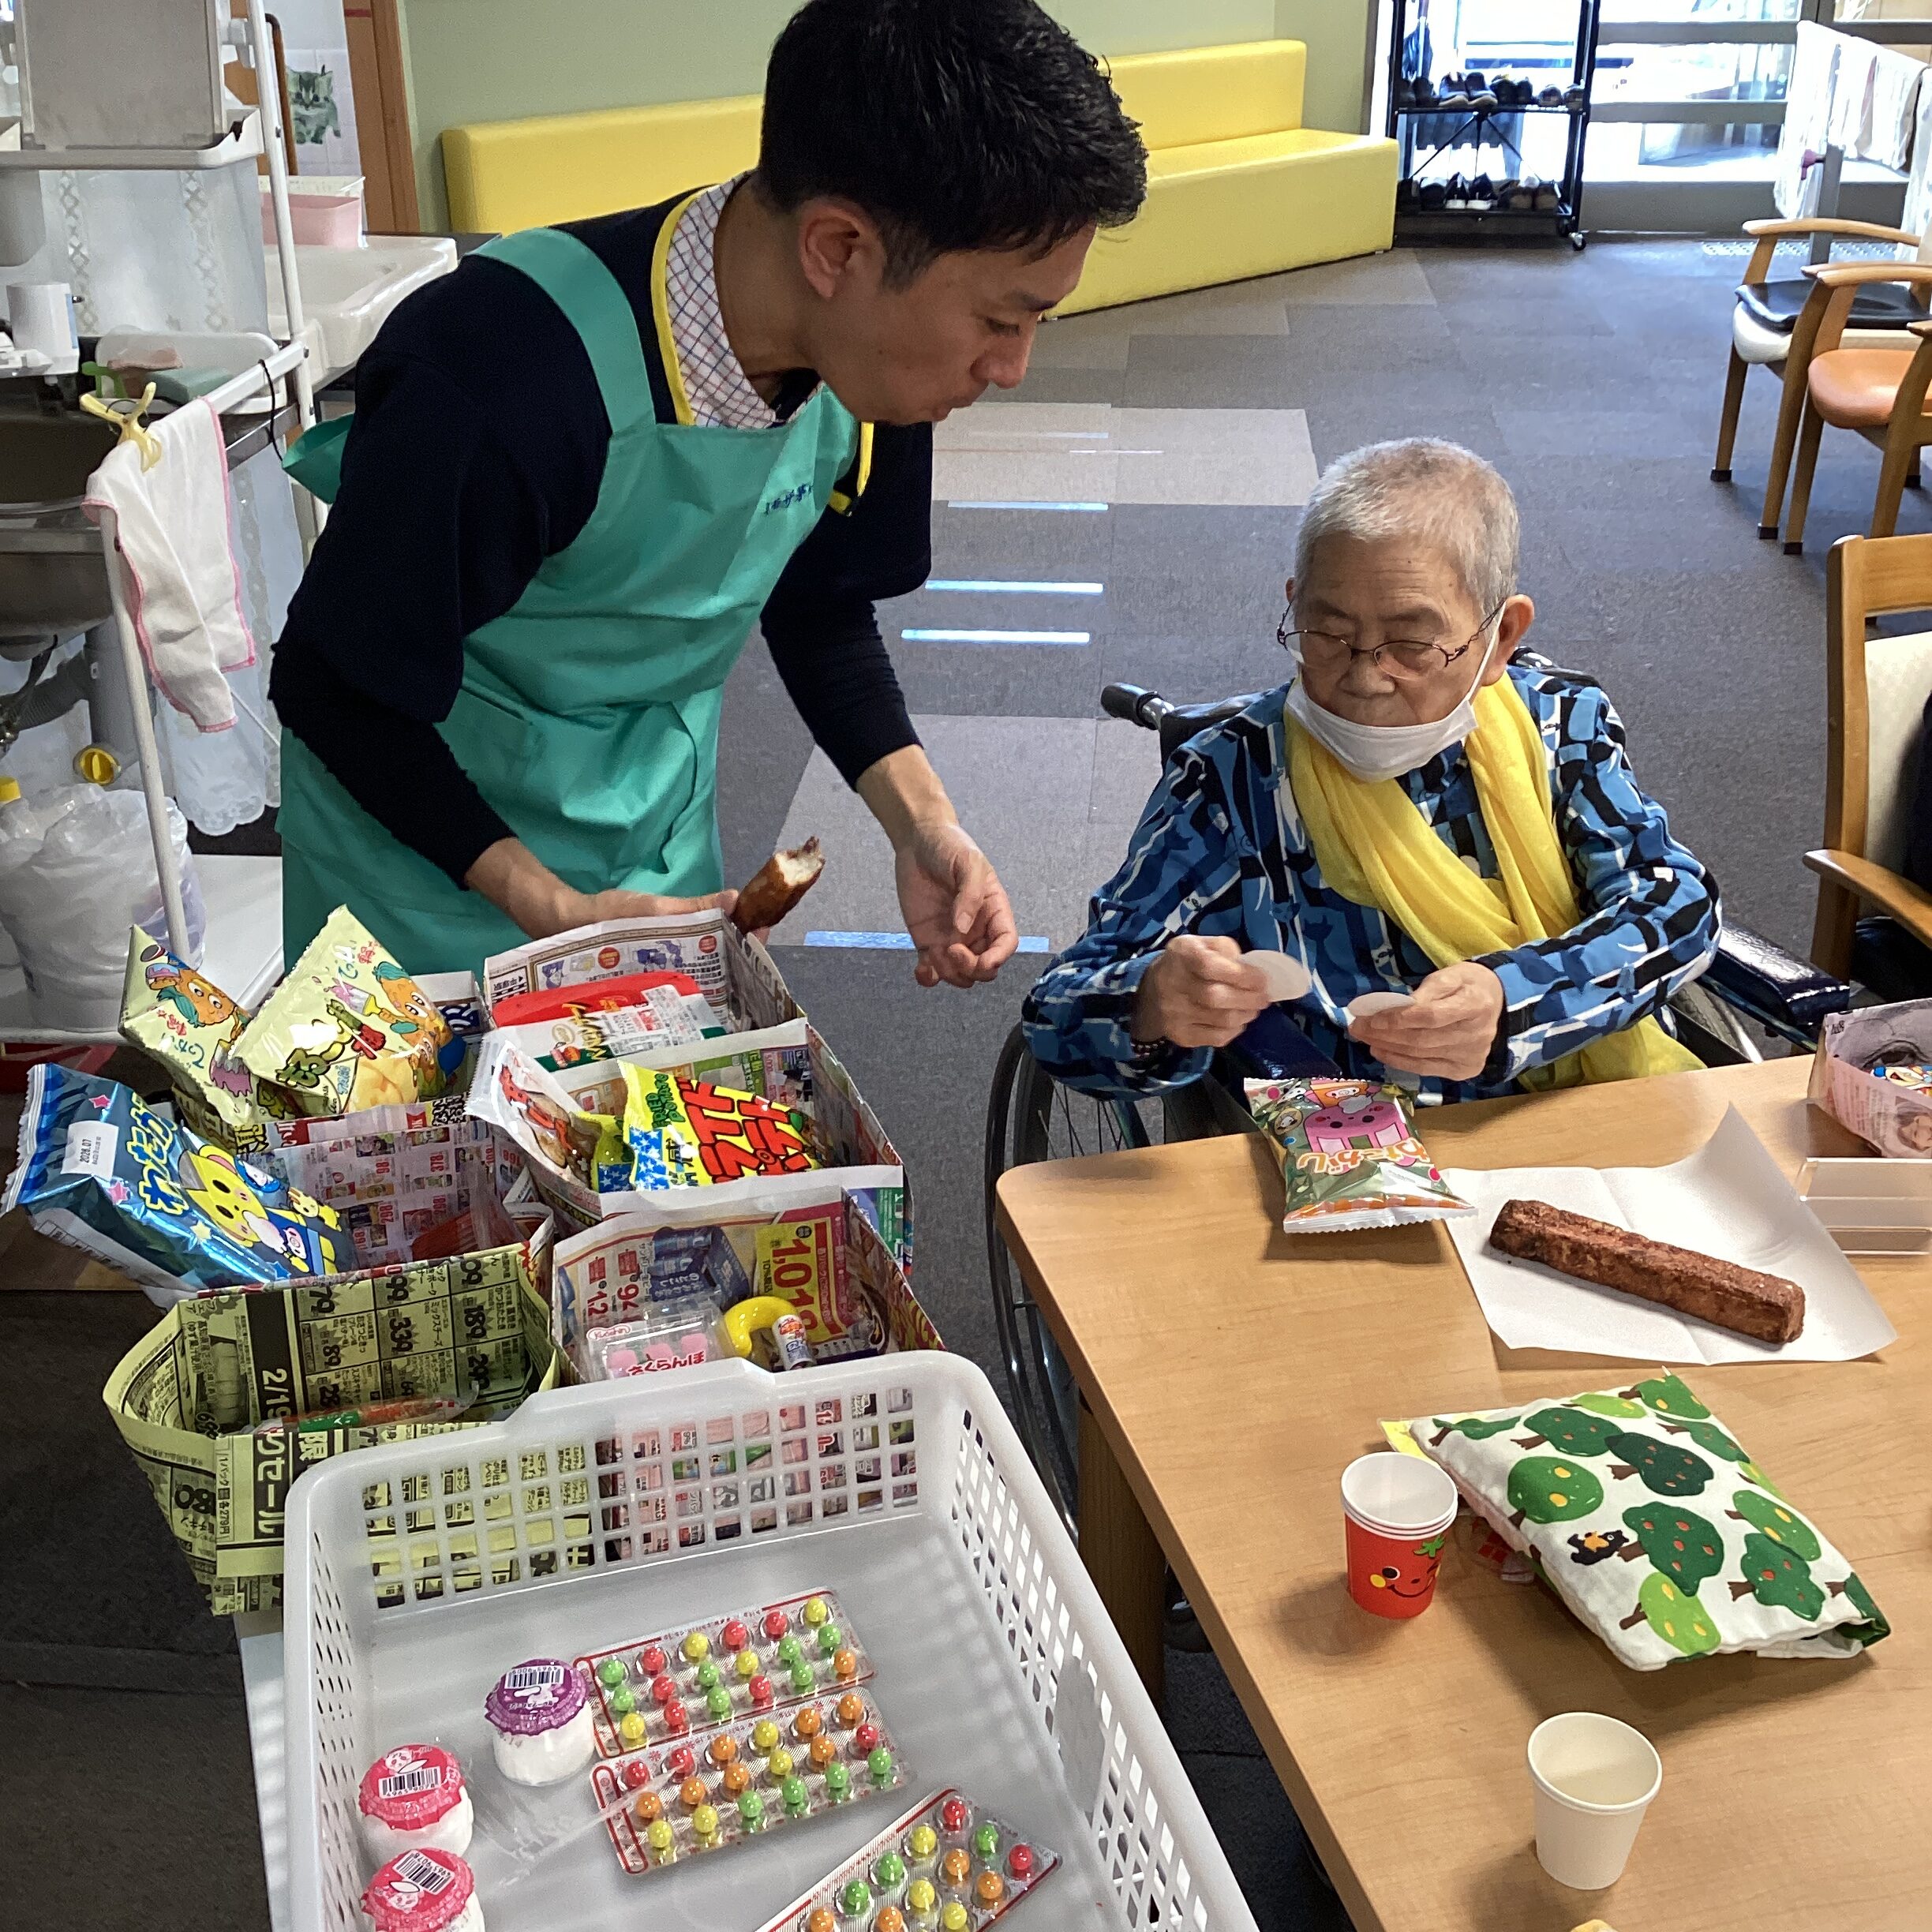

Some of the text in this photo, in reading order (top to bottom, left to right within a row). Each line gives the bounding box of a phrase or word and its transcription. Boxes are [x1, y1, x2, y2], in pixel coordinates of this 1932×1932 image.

[676, 1079, 759, 1186] ライド
[376, 1161, 389, 1174] 98
[430, 1155, 444, 1173] 378
[1297, 1138, 1430, 1174] わたがし
[389, 1317, 413, 1352] 339
[432, 1301, 443, 1347] ミックスチーズ
[465, 1305, 485, 1339] 189
[627, 1351, 704, 1376] さくらんぼ
